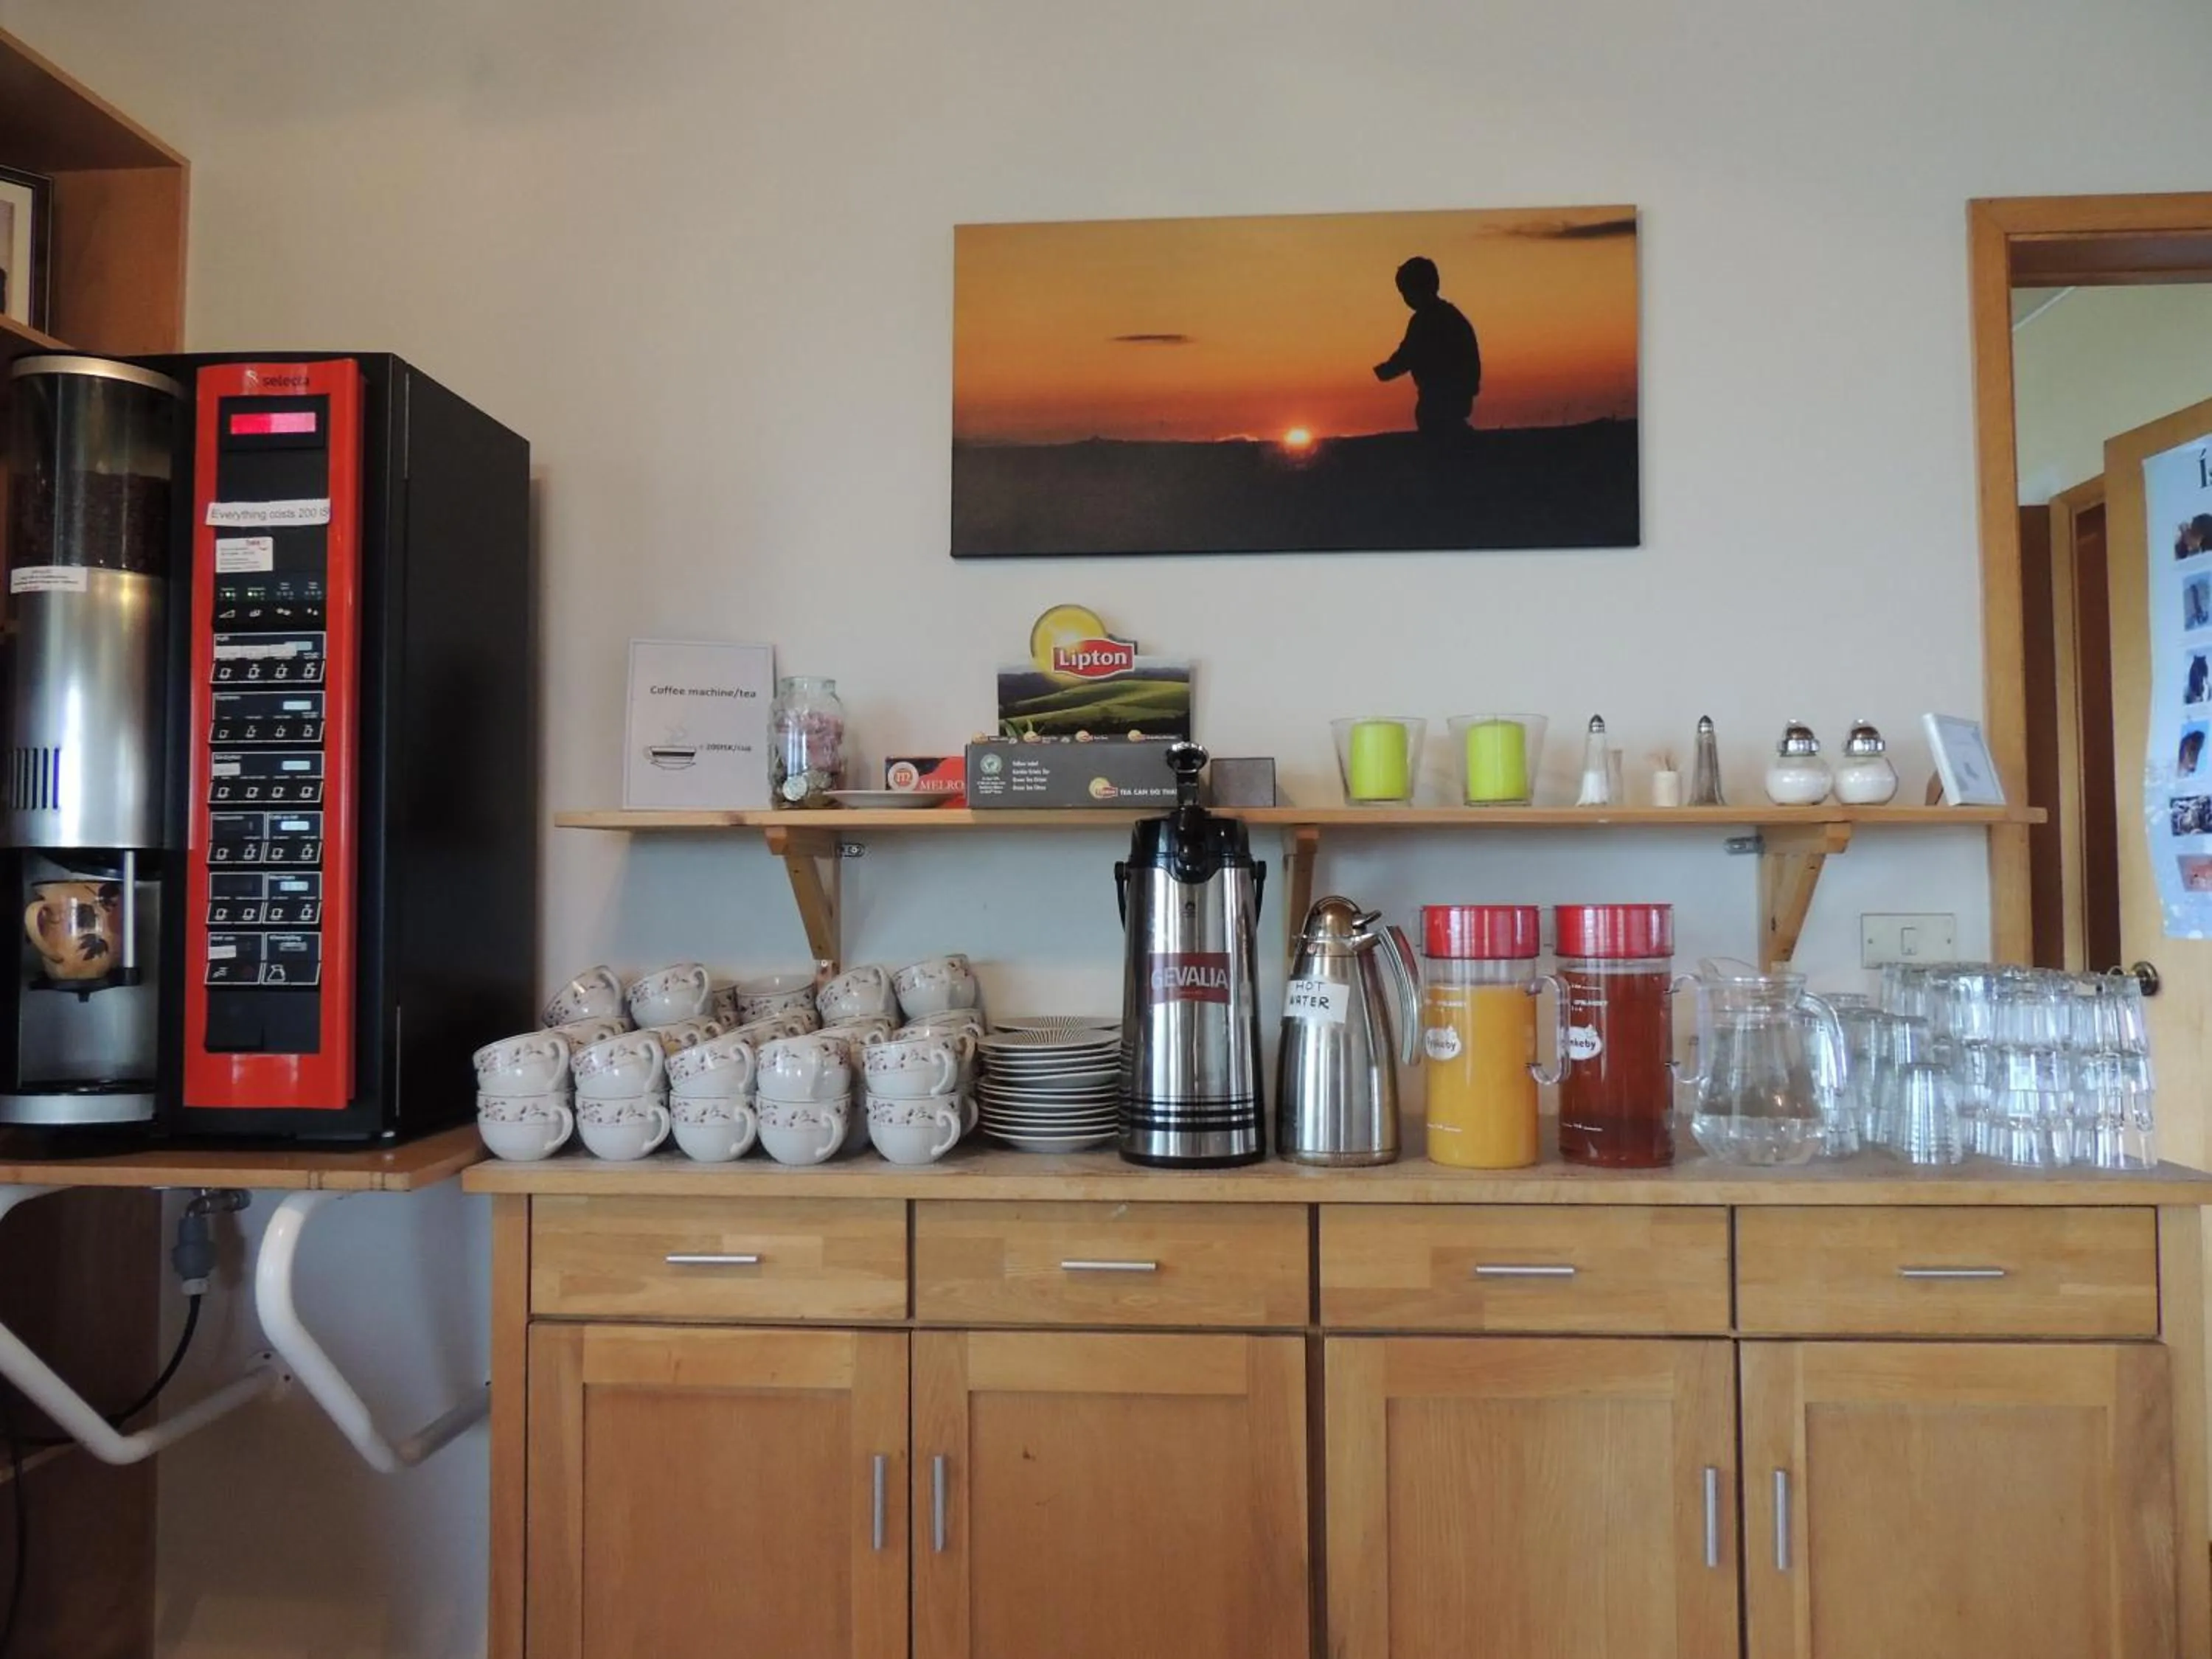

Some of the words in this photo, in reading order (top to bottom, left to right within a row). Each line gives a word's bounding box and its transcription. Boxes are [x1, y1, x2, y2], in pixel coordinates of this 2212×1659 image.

[212, 508, 266, 521] Everything
[299, 507, 317, 518] 200
[1060, 650, 1127, 669] Lipton
[650, 685, 686, 695] Coffee
[688, 686, 757, 698] machine/tea
[1151, 966, 1228, 990] GEVALIA
[1295, 981, 1326, 992] HOT
